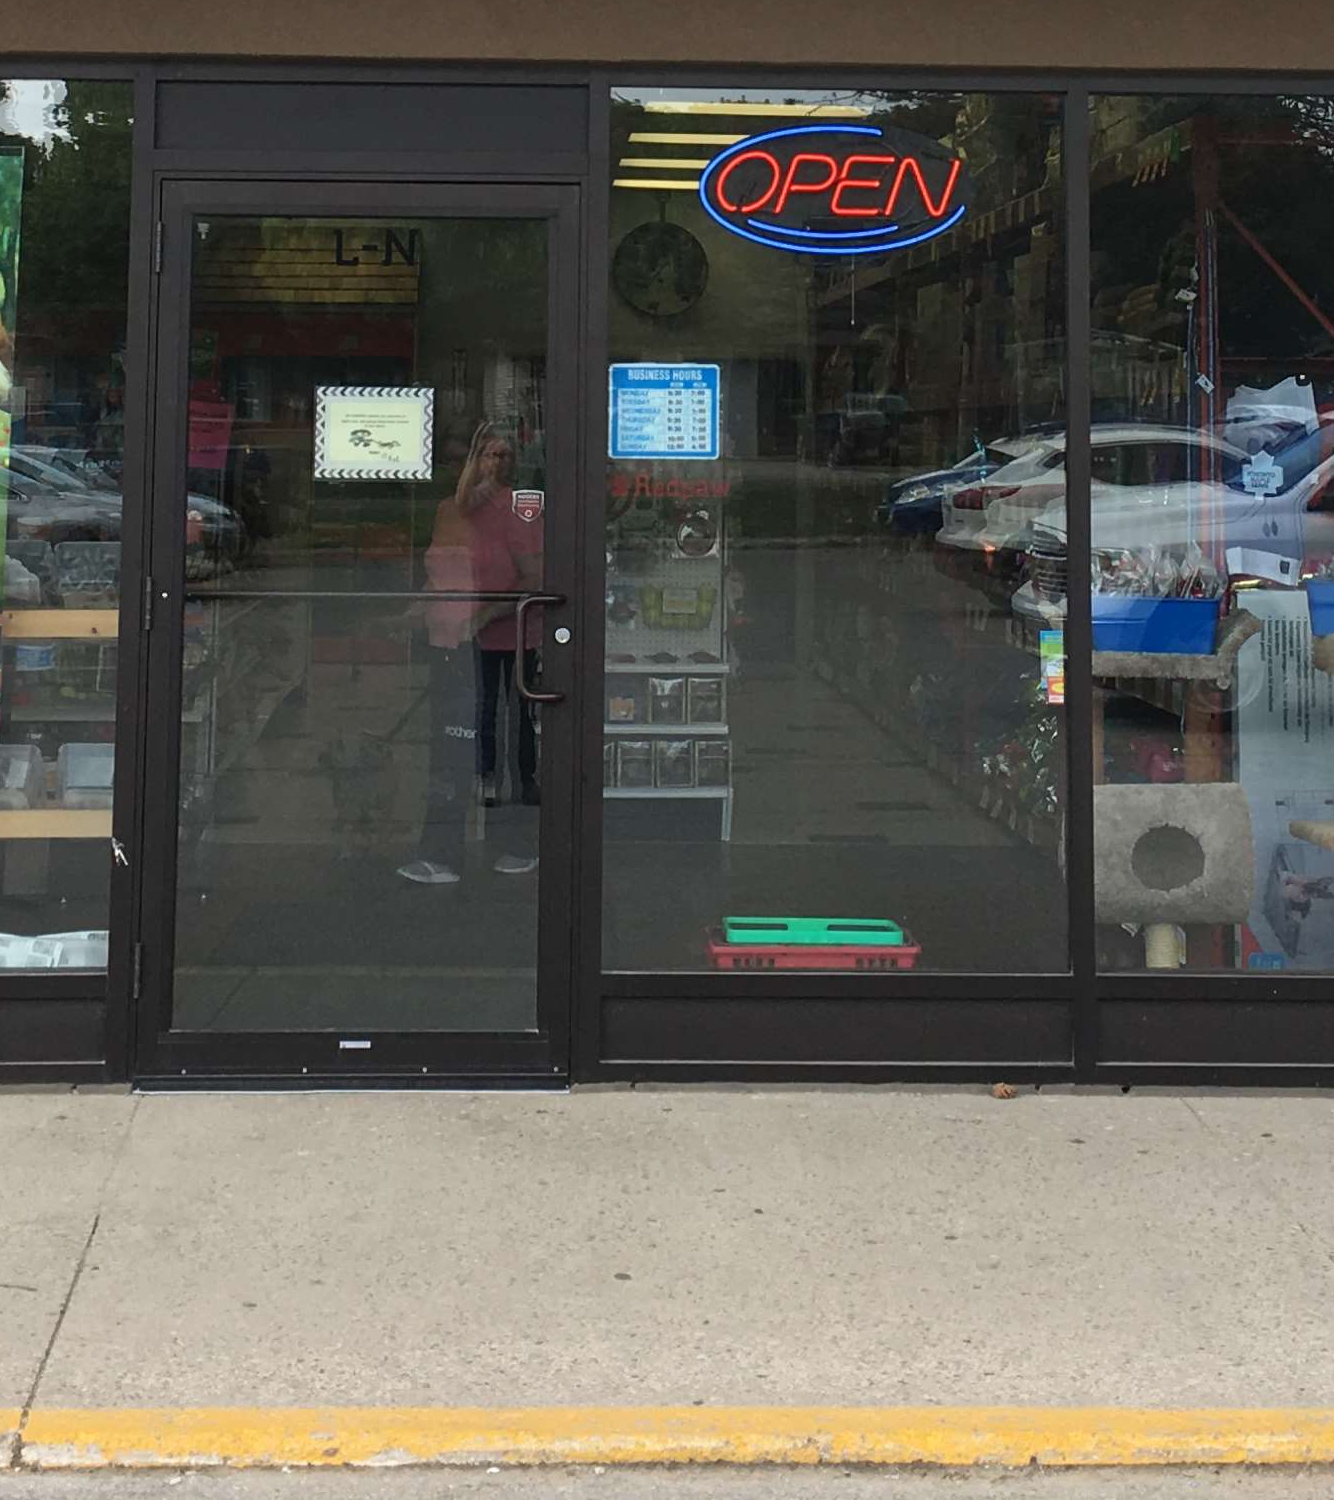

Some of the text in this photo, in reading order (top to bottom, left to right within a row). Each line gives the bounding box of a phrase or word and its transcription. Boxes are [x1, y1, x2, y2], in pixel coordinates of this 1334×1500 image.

[715, 150, 962, 218] OPEN
[627, 368, 703, 381] BUSINESS HOURS
